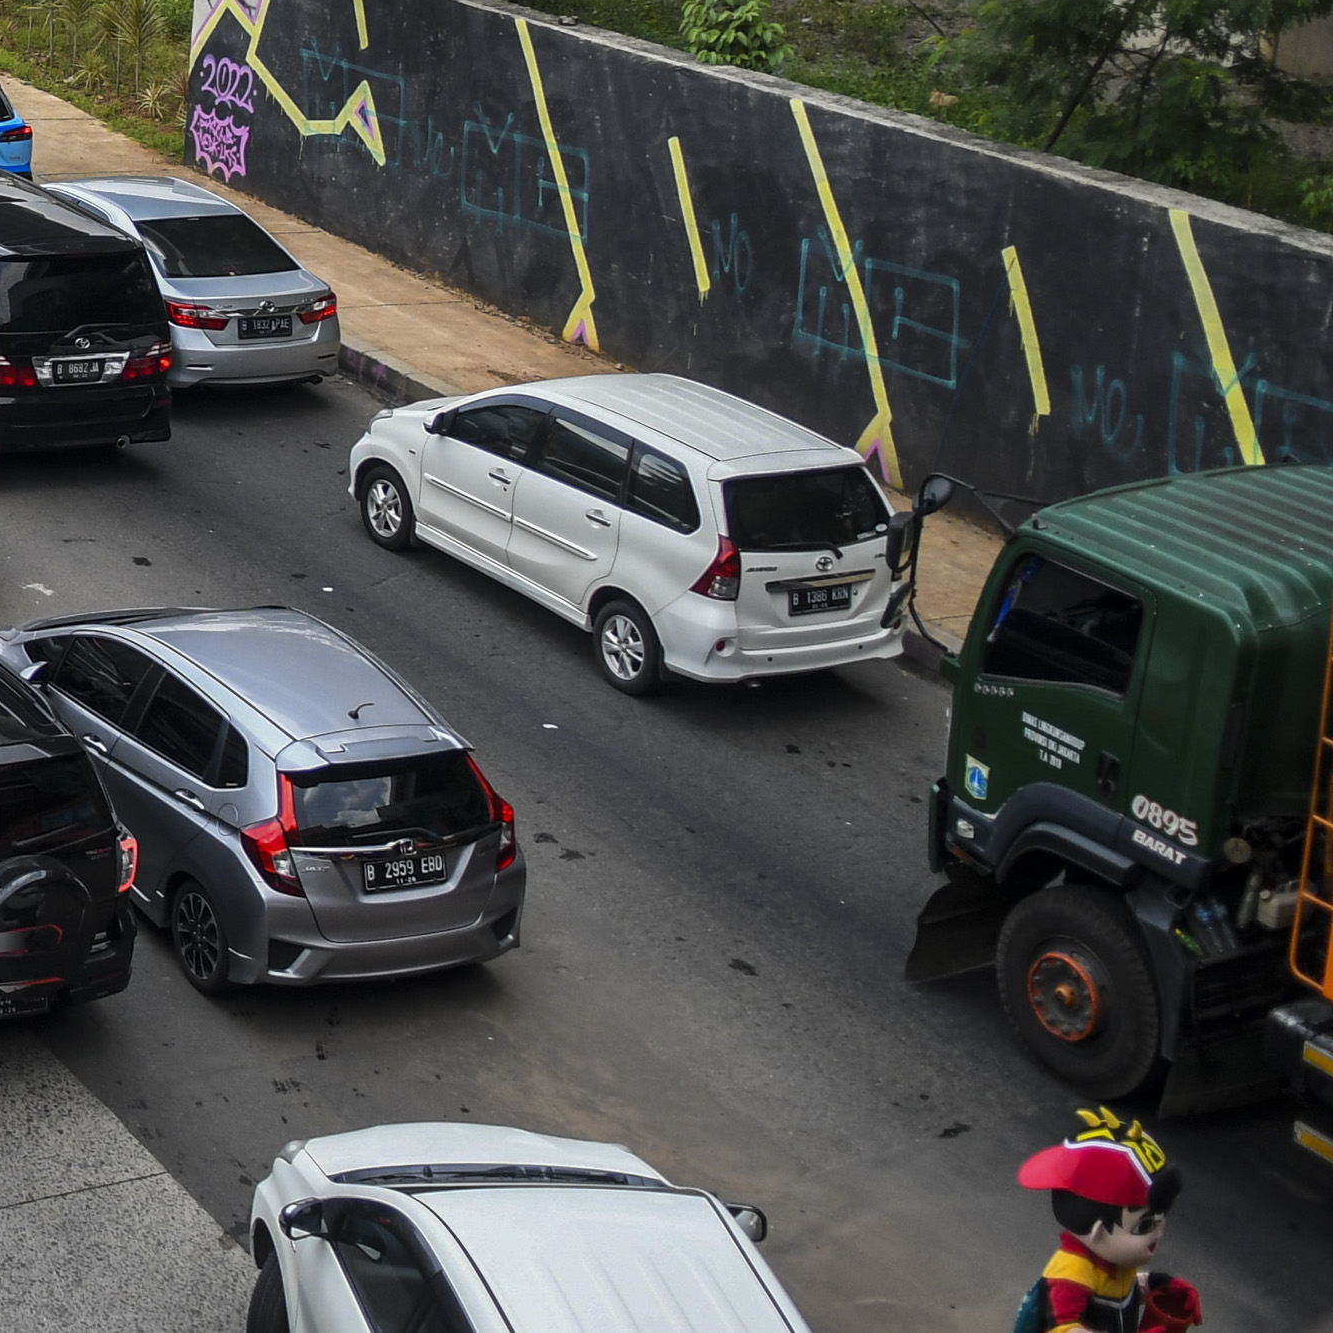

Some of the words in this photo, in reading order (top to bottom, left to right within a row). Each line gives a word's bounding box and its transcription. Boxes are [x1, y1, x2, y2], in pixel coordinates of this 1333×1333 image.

[242, 322, 248, 331] B
[252, 319, 271, 331] 1832
[56, 364, 63, 375] B
[68, 362, 89, 374] 8682
[793, 593, 799, 606] B
[806, 591, 828, 604] 1386
[831, 588, 849, 601] KRN
[1132, 794, 1199, 846] 0895
[1132, 829, 1187, 865] BARAT
[367, 864, 376, 881] B
[385, 860, 415, 878] 2959
[421, 855, 444, 873] EBD
